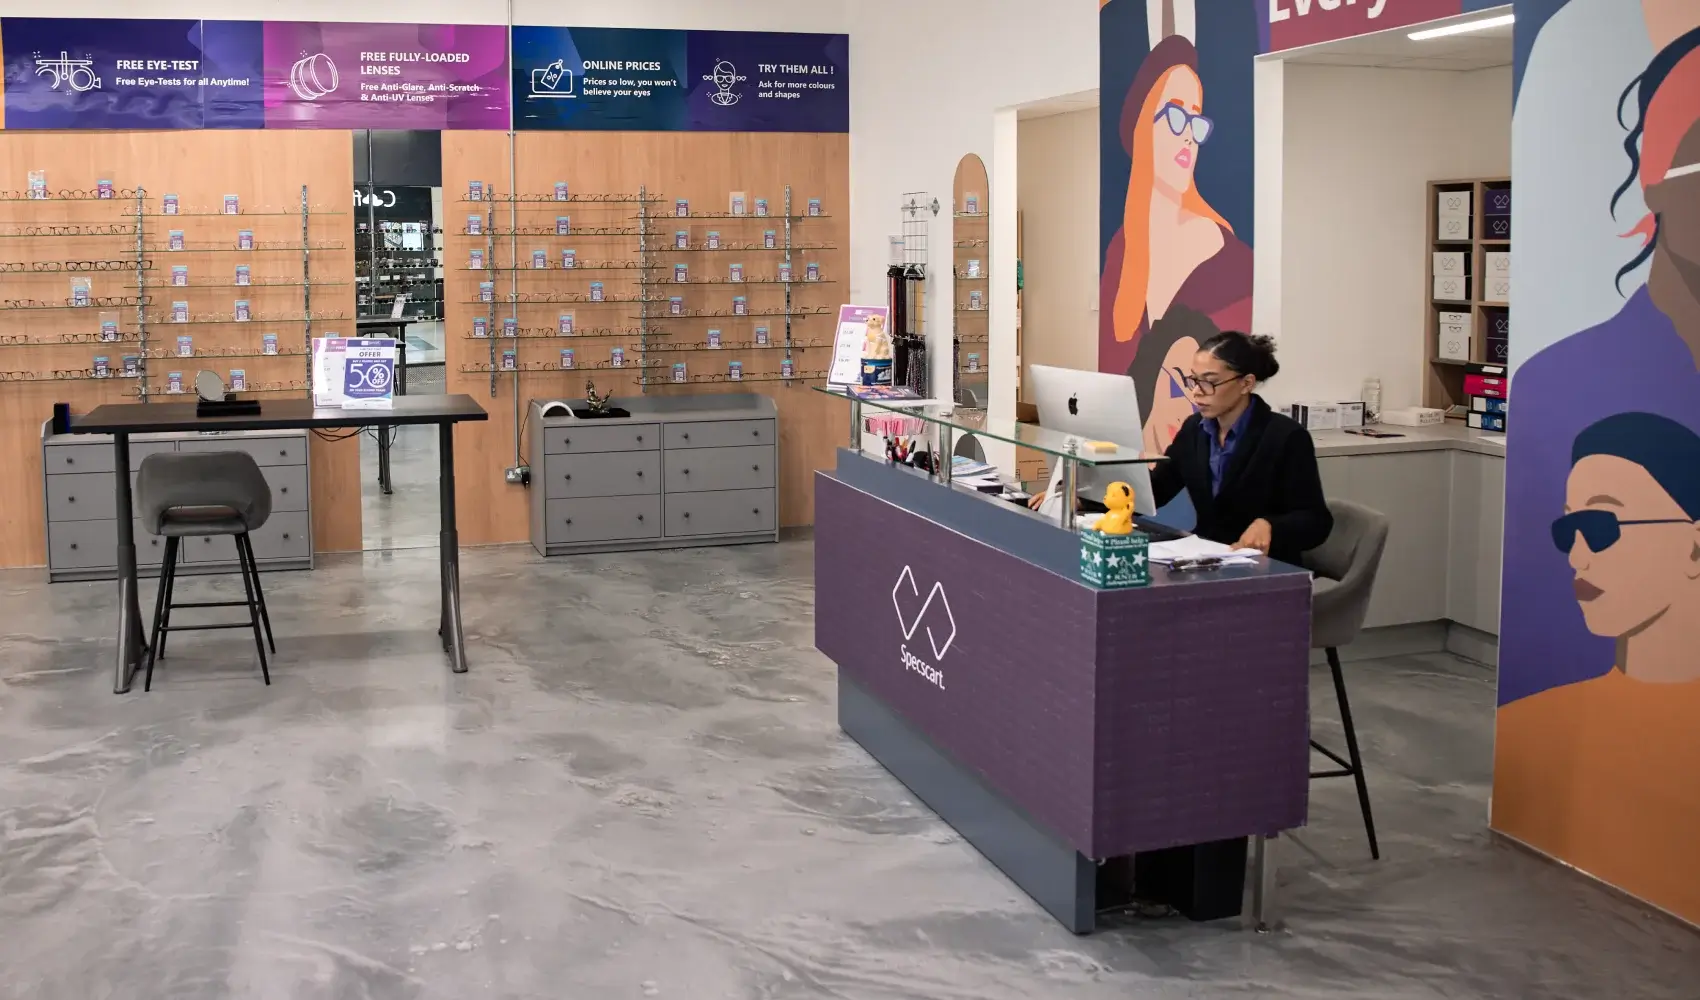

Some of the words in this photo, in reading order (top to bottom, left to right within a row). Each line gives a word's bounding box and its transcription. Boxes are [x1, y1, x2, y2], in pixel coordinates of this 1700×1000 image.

[360, 52, 386, 62] FREE
[389, 52, 470, 62] FULLY-LOADED
[116, 60, 144, 69] FREE
[147, 60, 198, 70] EYE-TEST
[583, 60, 623, 70] ONLINE
[626, 62, 661, 70] PRICES
[758, 64, 777, 73] TRY
[780, 64, 808, 74] THEM
[811, 66, 828, 74] ALL
[360, 66, 400, 75] LENSES
[116, 78, 136, 86] Free
[138, 78, 181, 87] Eye-Tests
[184, 78, 196, 86] for
[198, 78, 208, 86] all
[210, 78, 249, 87] Anytime!
[620, 78, 635, 86] low,
[381, 83, 426, 92] Anti-Glare,
[407, 94, 434, 102] Lenses
[634, 90, 651, 98] eyes
[774, 91, 800, 99] shapes
[901, 644, 945, 690] Specscart
